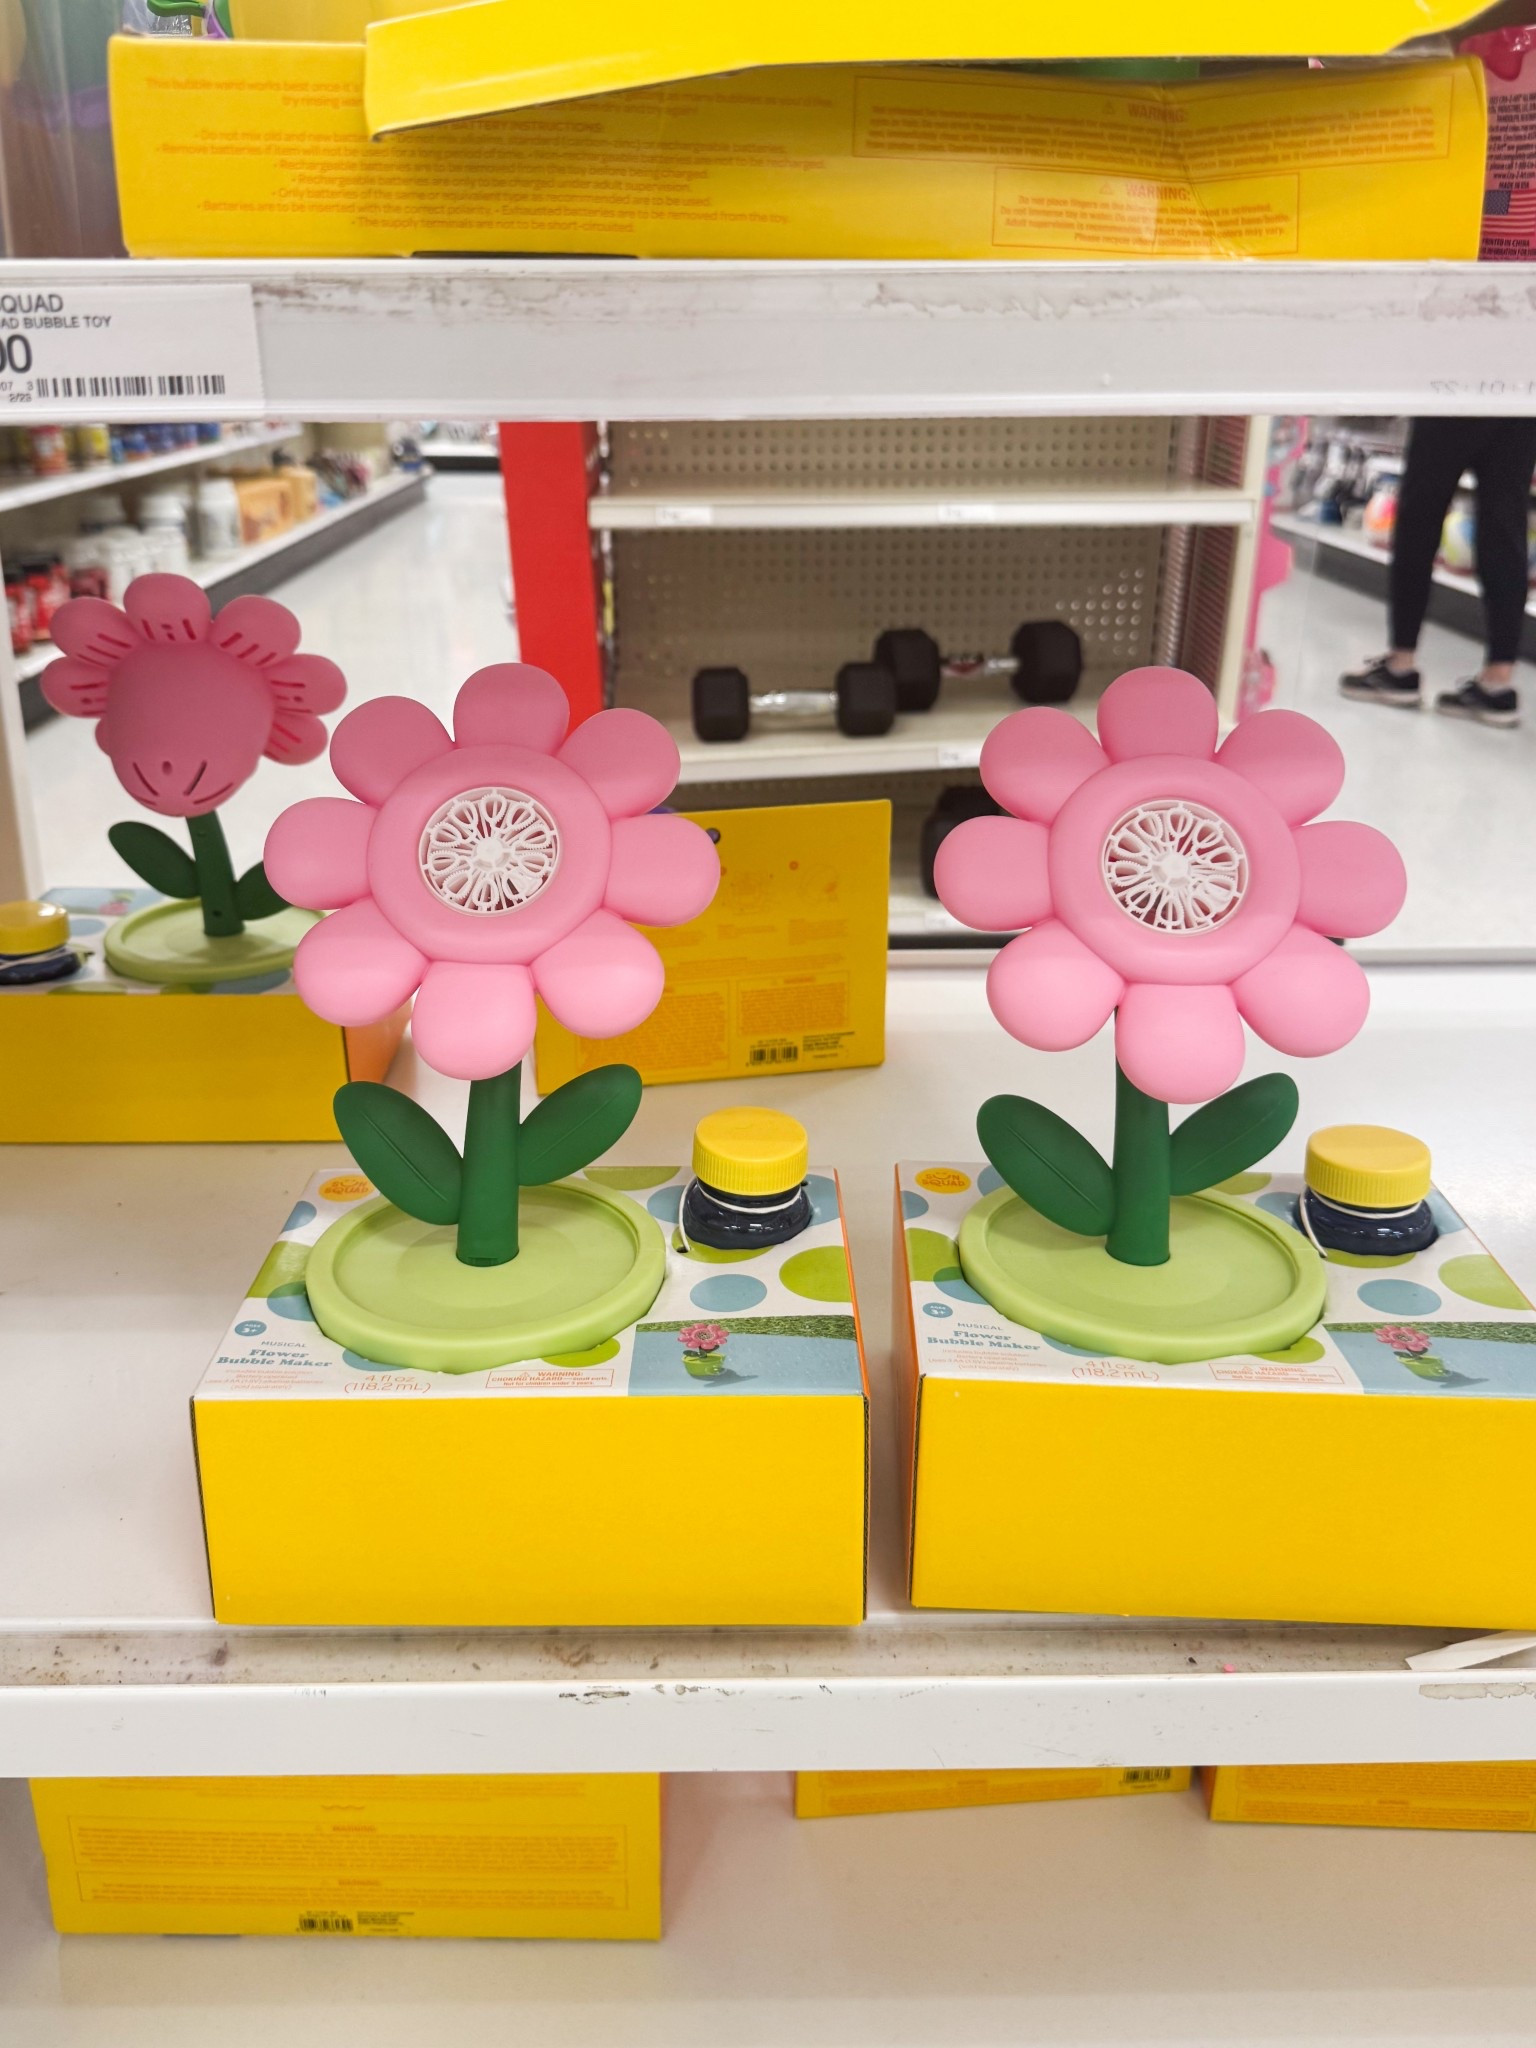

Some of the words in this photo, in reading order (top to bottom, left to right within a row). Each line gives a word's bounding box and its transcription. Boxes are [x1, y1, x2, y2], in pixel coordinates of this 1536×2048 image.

[0, 293, 64, 314] QUAD
[23, 316, 80, 329] BUBBLE
[82, 315, 111, 328] TOY
[0, 333, 33, 374] 0
[26, 381, 34, 391] 3
[9, 393, 32, 403] 2/23
[921, 1178, 966, 1187] SQUAD
[323, 1186, 370, 1195] SQUAD
[957, 1322, 1004, 1331] MUSICAL
[953, 1330, 1012, 1341] Flower
[927, 1336, 985, 1347] Bubble
[988, 1340, 1041, 1351] Maker
[249, 1348, 310, 1358] Flower
[215, 1356, 276, 1365] Bubble
[278, 1359, 333, 1367] Maker
[1071, 1367, 1121, 1379] (118.2
[1123, 1370, 1160, 1382] mL)
[344, 1382, 393, 1394] (118.2
[396, 1382, 432, 1394] mL)
